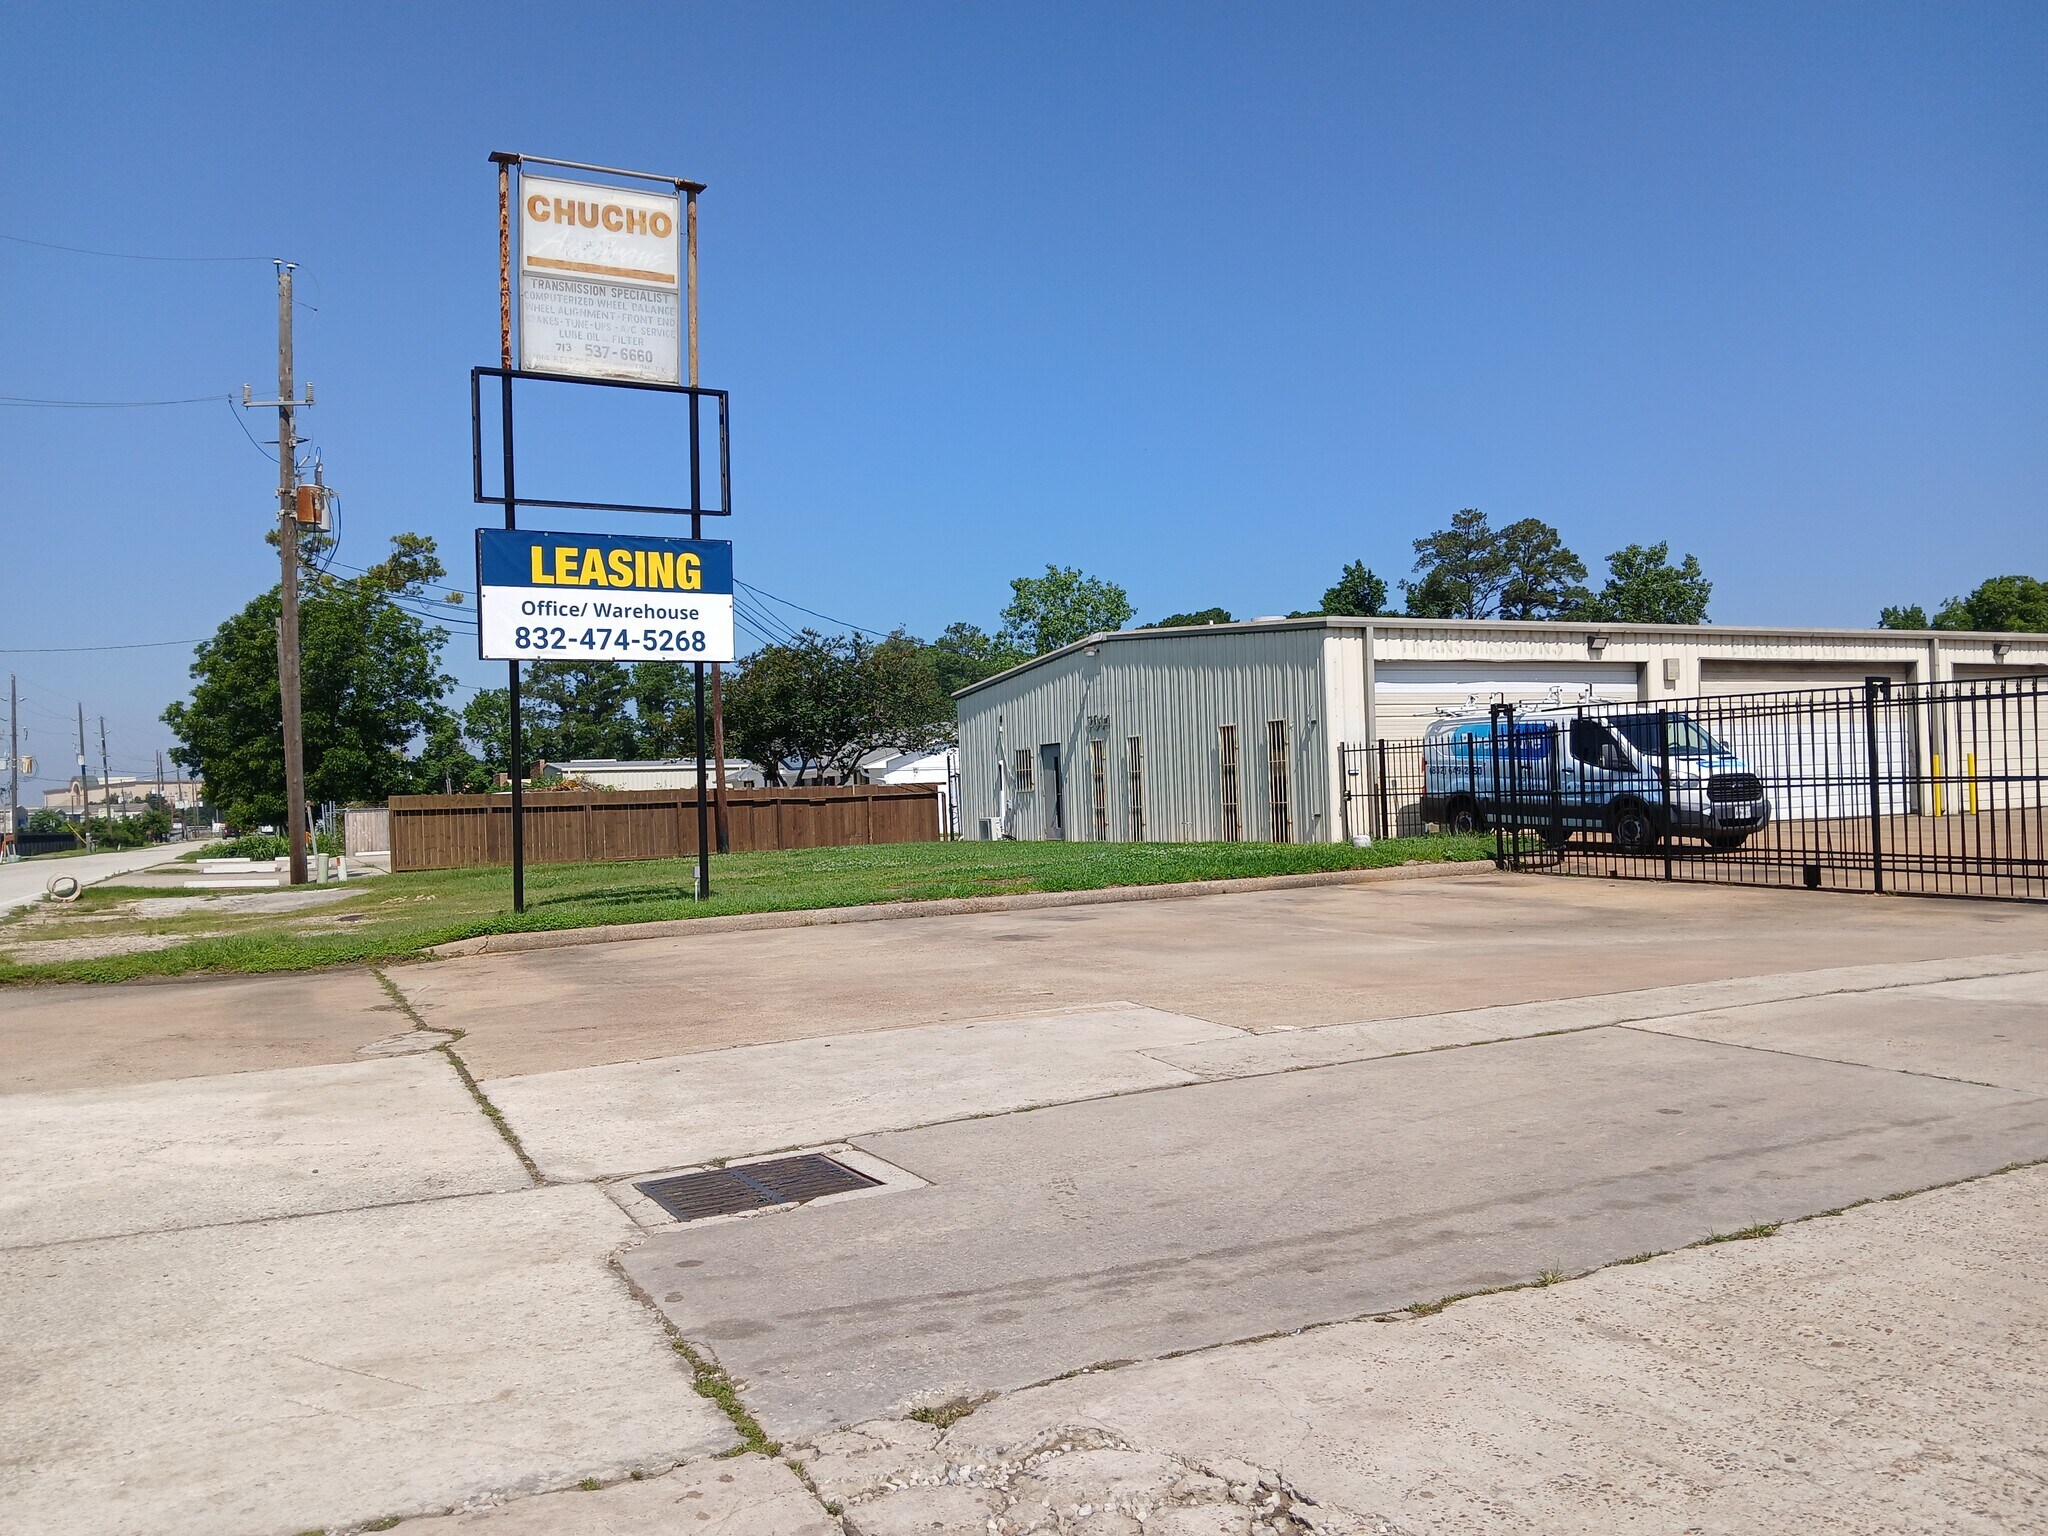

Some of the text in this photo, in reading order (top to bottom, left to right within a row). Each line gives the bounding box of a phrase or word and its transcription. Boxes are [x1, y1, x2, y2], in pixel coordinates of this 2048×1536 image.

[528, 195, 672, 239] CHUCHO
[524, 290, 675, 316] COMPUTERIZED WHEEL BALANCE
[531, 278, 671, 304] TRANSMISSION SPECIALIST
[525, 302, 676, 327] WHEEL ALIGNMENT FRONT END
[612, 334, 644, 346] FILTER
[640, 327, 676, 339] SERVICE
[556, 342, 653, 363] 713 537-6660
[530, 545, 702, 590] LEASING
[521, 600, 699, 620] Office/ Warehouse
[515, 626, 706, 652] 832-474-5268
